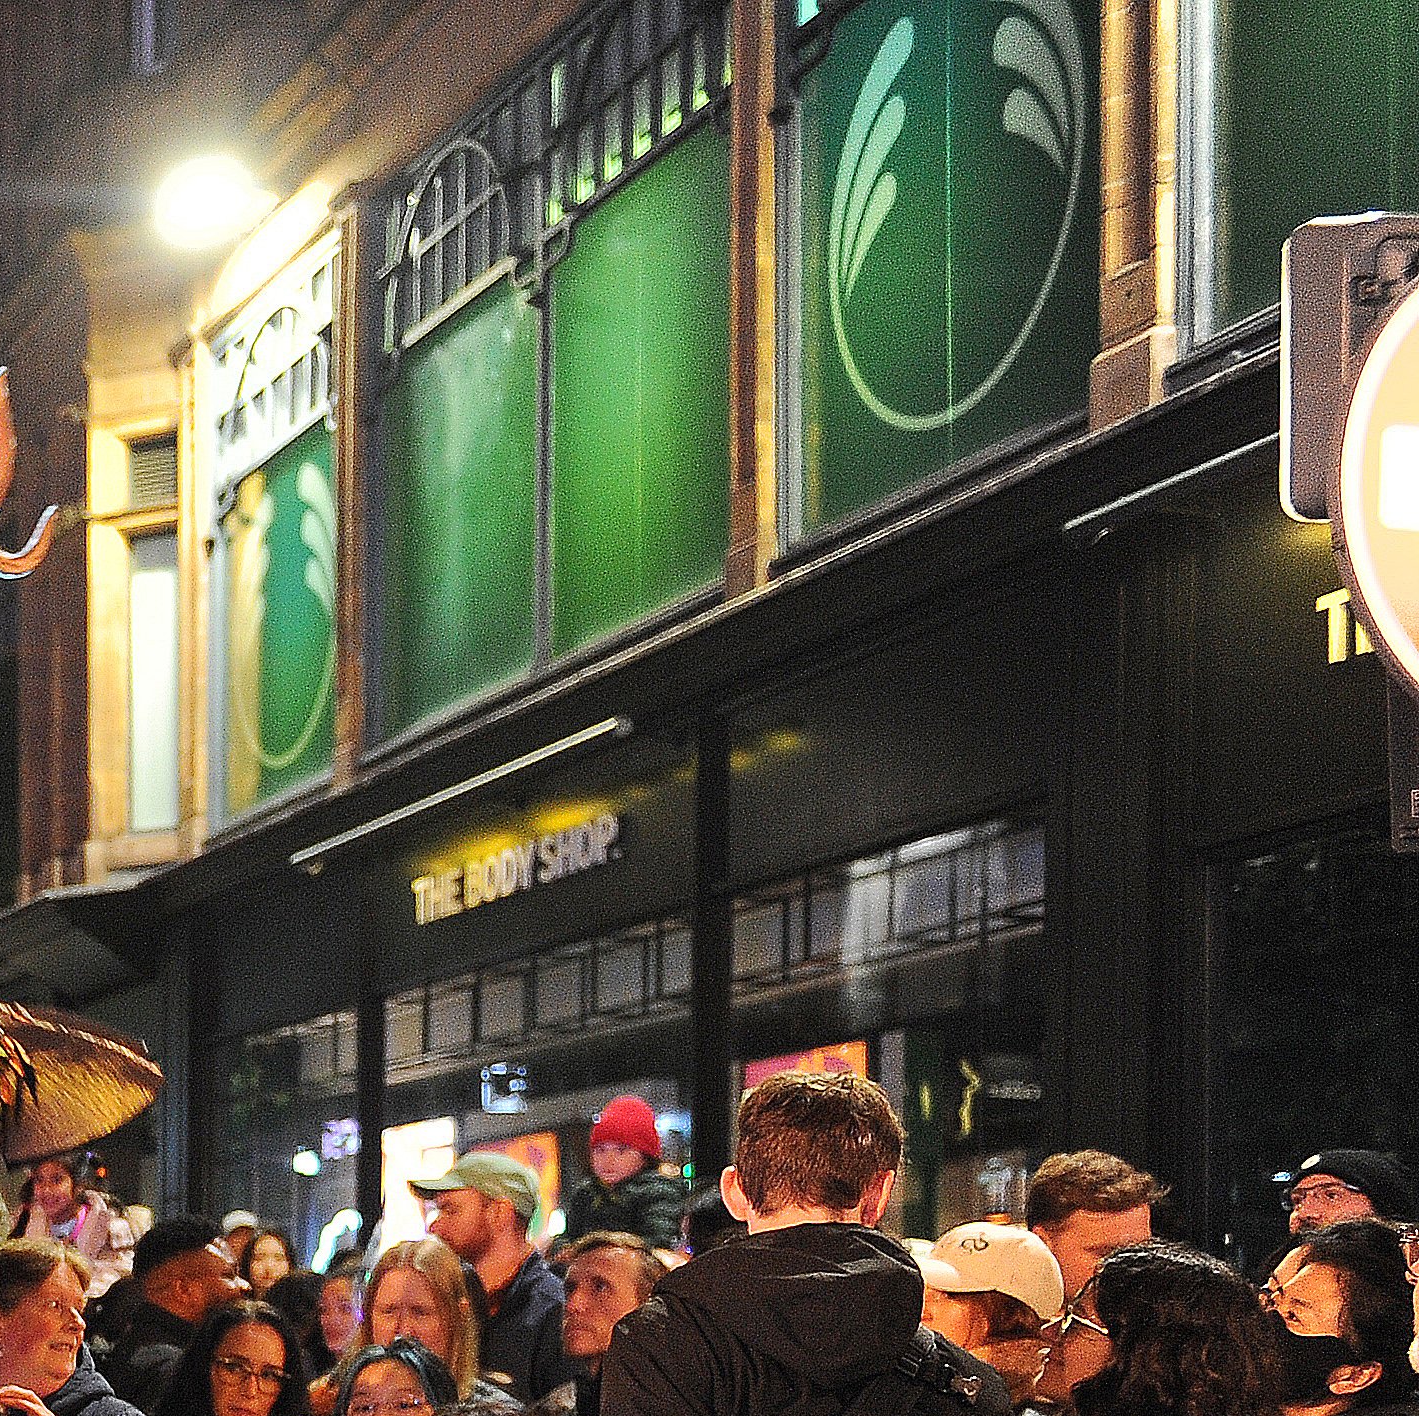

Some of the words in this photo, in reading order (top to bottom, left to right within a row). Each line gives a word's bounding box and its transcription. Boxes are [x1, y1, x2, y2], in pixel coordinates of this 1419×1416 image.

[411, 867, 464, 926] THE
[464, 839, 536, 909] BODY
[537, 812, 619, 884] SHOP
